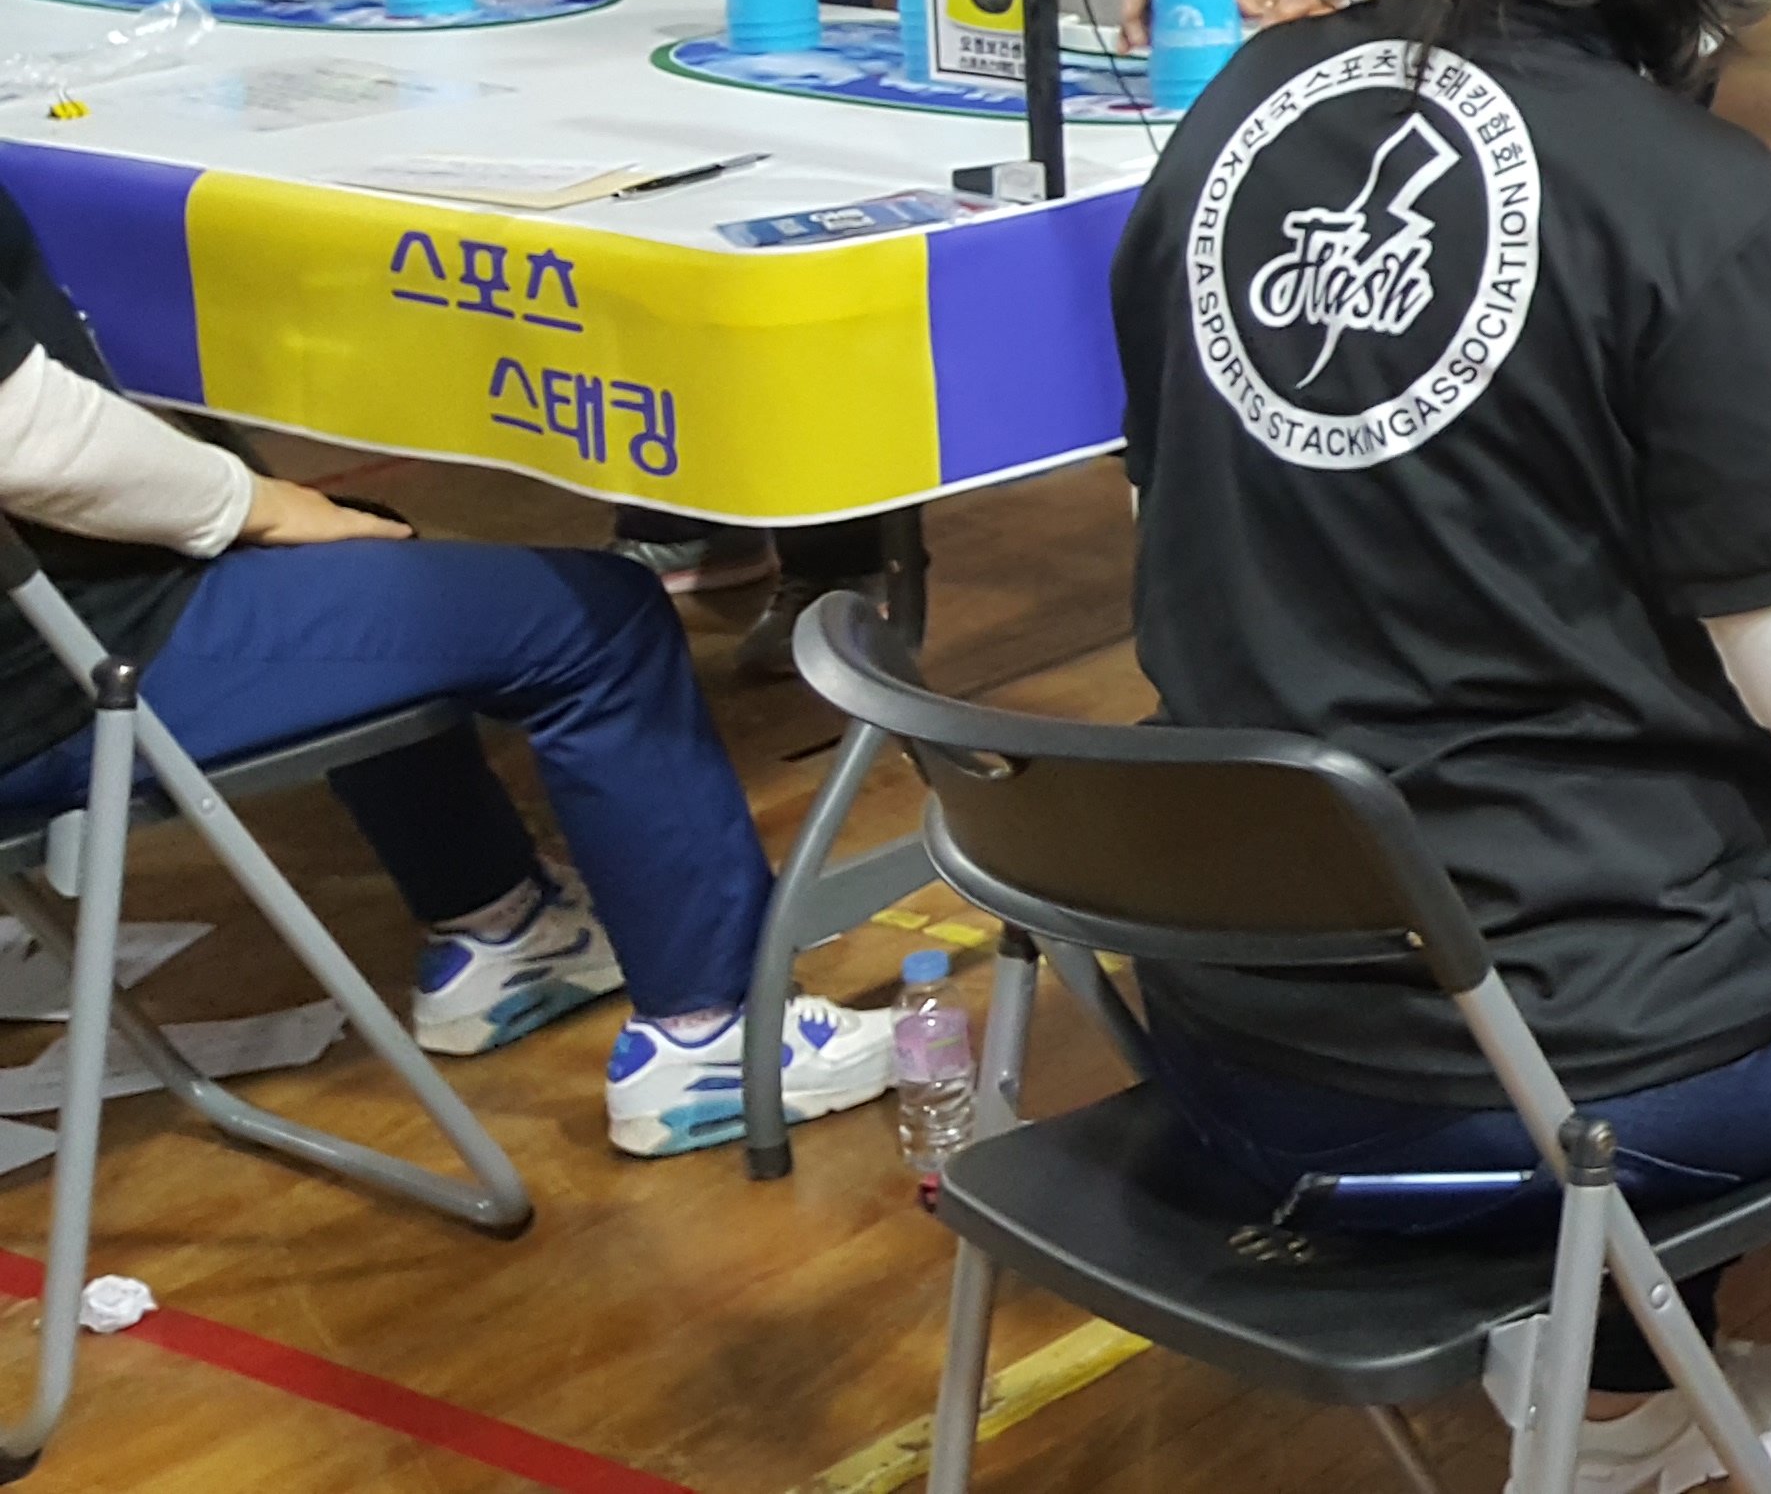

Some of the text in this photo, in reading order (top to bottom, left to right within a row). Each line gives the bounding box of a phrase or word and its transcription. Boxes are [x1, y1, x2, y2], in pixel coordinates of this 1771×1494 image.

[390, 228, 585, 333] 스포츠
[1194, 154, 1243, 285] KOREA
[488, 356, 680, 478] 스태킹
[1198, 293, 1266, 422] SPORTS
